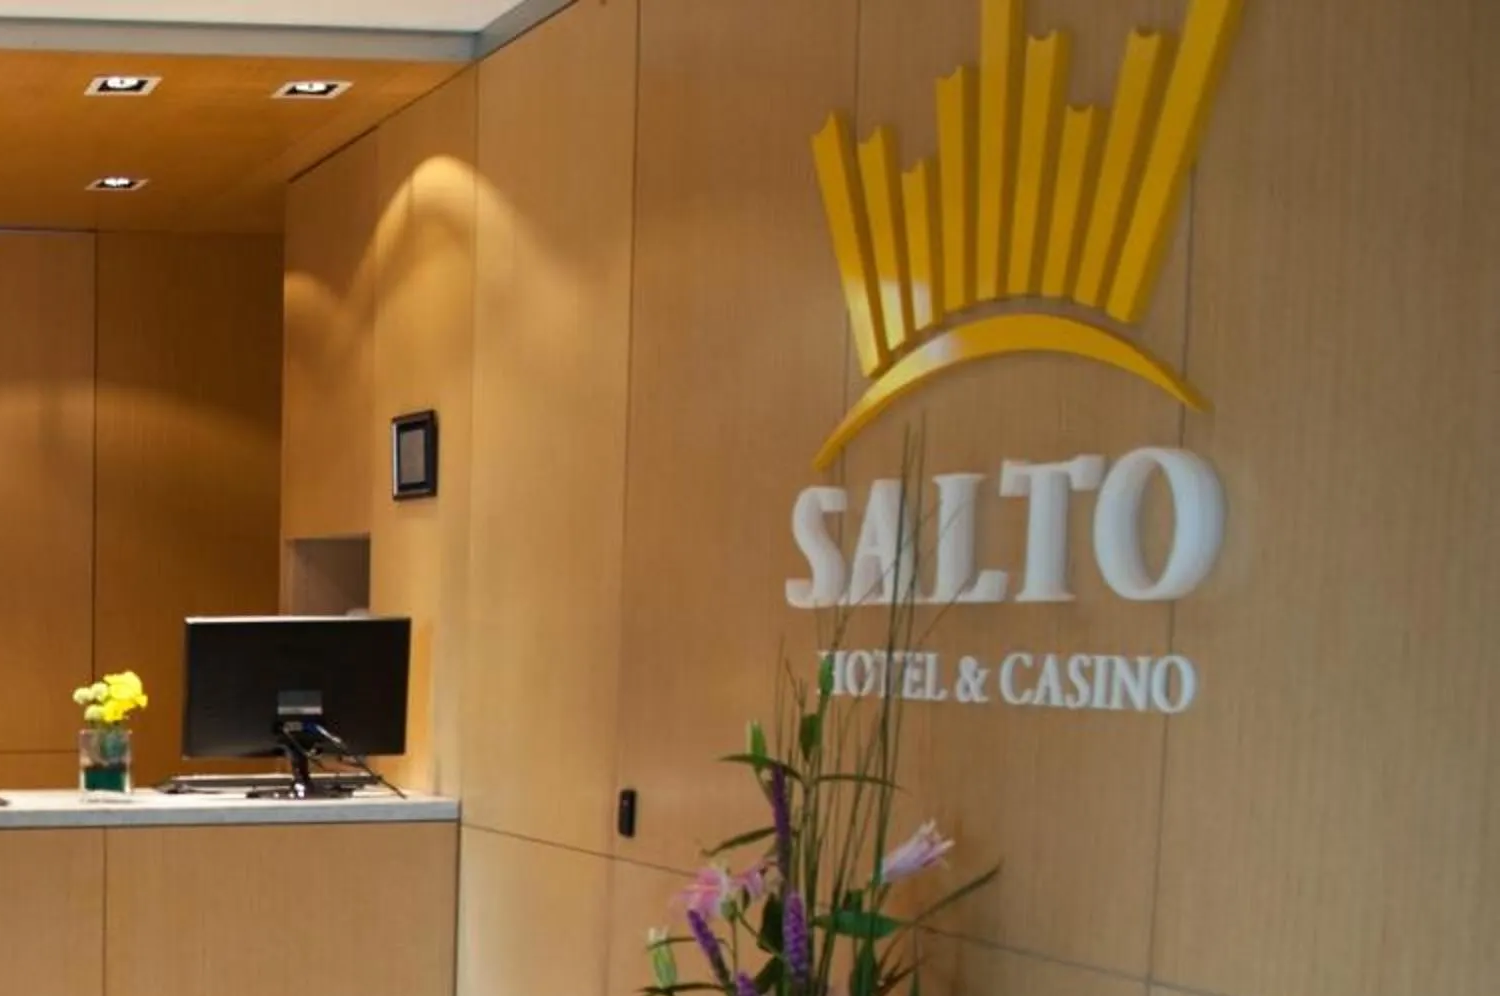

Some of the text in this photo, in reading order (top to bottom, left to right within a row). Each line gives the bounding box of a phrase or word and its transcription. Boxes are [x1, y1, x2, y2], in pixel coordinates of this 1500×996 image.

[785, 446, 1227, 609] SALTO
[956, 655, 990, 704] &
[999, 653, 1198, 714] CASINO
